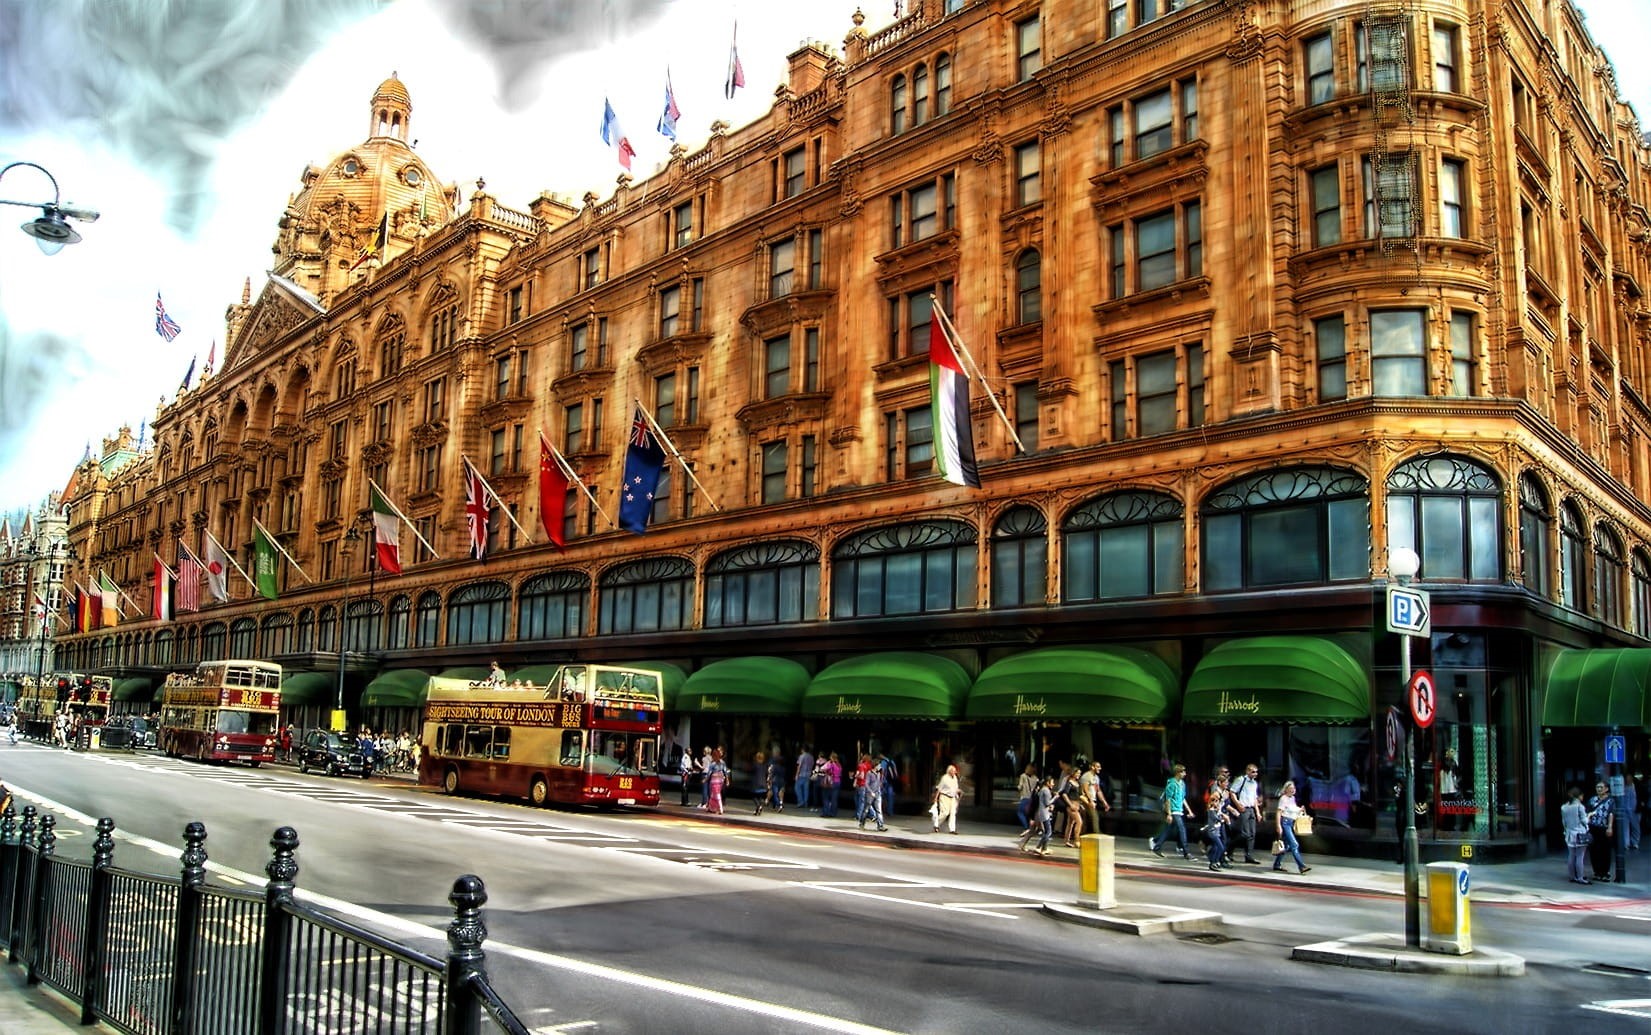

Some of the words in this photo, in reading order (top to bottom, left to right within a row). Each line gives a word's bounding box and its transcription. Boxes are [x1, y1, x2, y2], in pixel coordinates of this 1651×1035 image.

[1397, 598, 1409, 622] P
[563, 704, 581, 713] BIG
[1013, 694, 1047, 714] Harrods
[1216, 691, 1259, 714] Harrods
[429, 705, 479, 719] SIGHTSEEING
[480, 707, 503, 720] TOUR
[503, 707, 516, 721] OF
[517, 707, 556, 722] LONDON
[562, 712, 581, 721] BUS
[561, 720, 580, 728] TOURS
